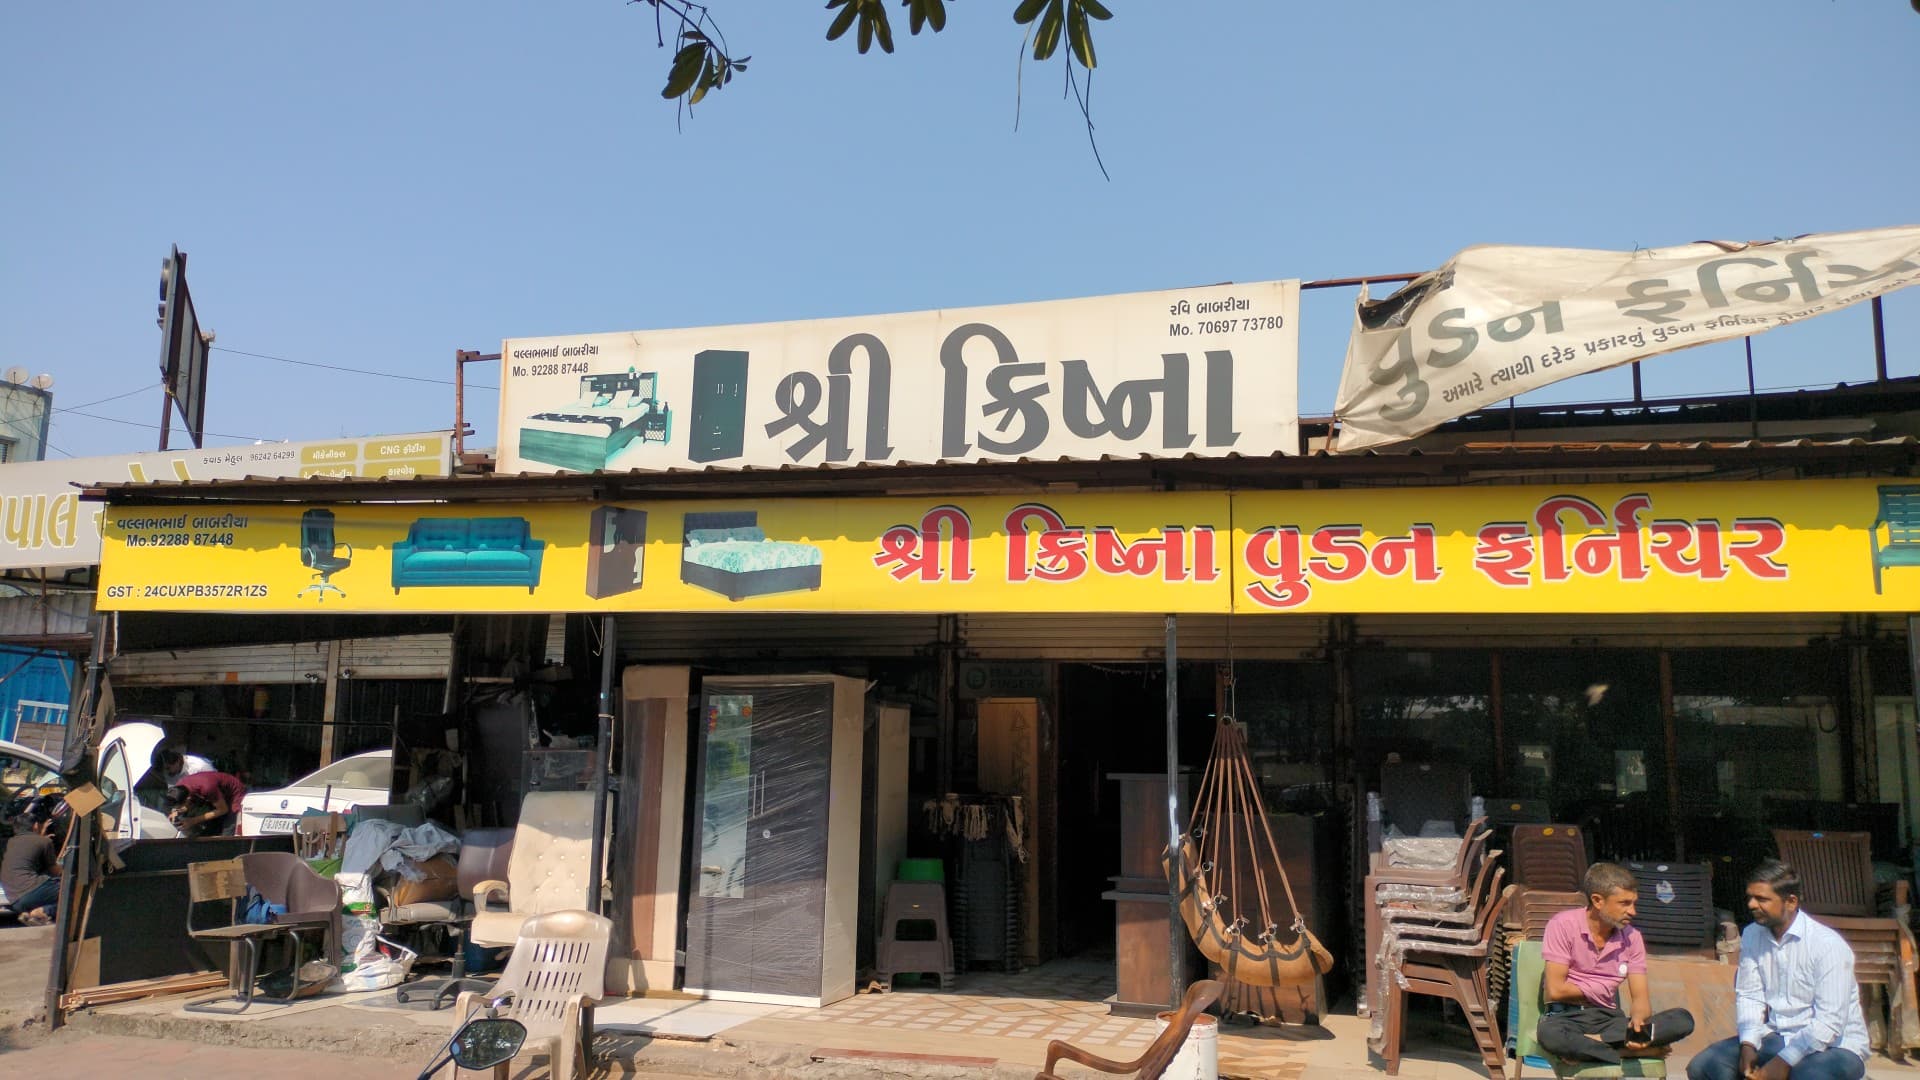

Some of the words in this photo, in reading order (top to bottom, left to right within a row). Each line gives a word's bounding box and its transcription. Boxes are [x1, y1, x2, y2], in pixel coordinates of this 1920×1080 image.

[1169, 300, 1191, 316] રવિ
[1196, 296, 1250, 315] બાબરીયા
[1169, 323, 1193, 337] Mo.
[1198, 319, 1238, 335] 70697
[1243, 315, 1284, 331] 73780
[513, 345, 559, 359] વલ્લભભાઈ
[562, 343, 599, 357] બાબરીયા
[1369, 300, 1564, 422] વુડન
[512, 366, 529, 377] Mo.
[531, 364, 559, 376] 92288
[561, 362, 589, 375] 87448
[1442, 372, 1485, 403] અમારે
[1541, 346, 1576, 368] દરેક
[1584, 326, 1646, 355] પ્રકારનું
[1652, 323, 1696, 343] વુડન
[764, 333, 895, 463] શ્રી
[940, 322, 1241, 457] ક્રિષ્ના
[380, 444, 400, 456] CNG
[0, 492, 79, 550] પાલ
[117, 514, 188, 530] વલ્લભભાઈ
[192, 513, 248, 529] બાબરીયા
[194, 532, 233, 547] 87448
[872, 504, 976, 583] શ્રી
[1004, 503, 1223, 583] ક્રિષ્ના
[1244, 523, 1444, 608] વુડન
[1473, 493, 1790, 589] ફર્નિચર
[107, 585, 133, 598] GST
